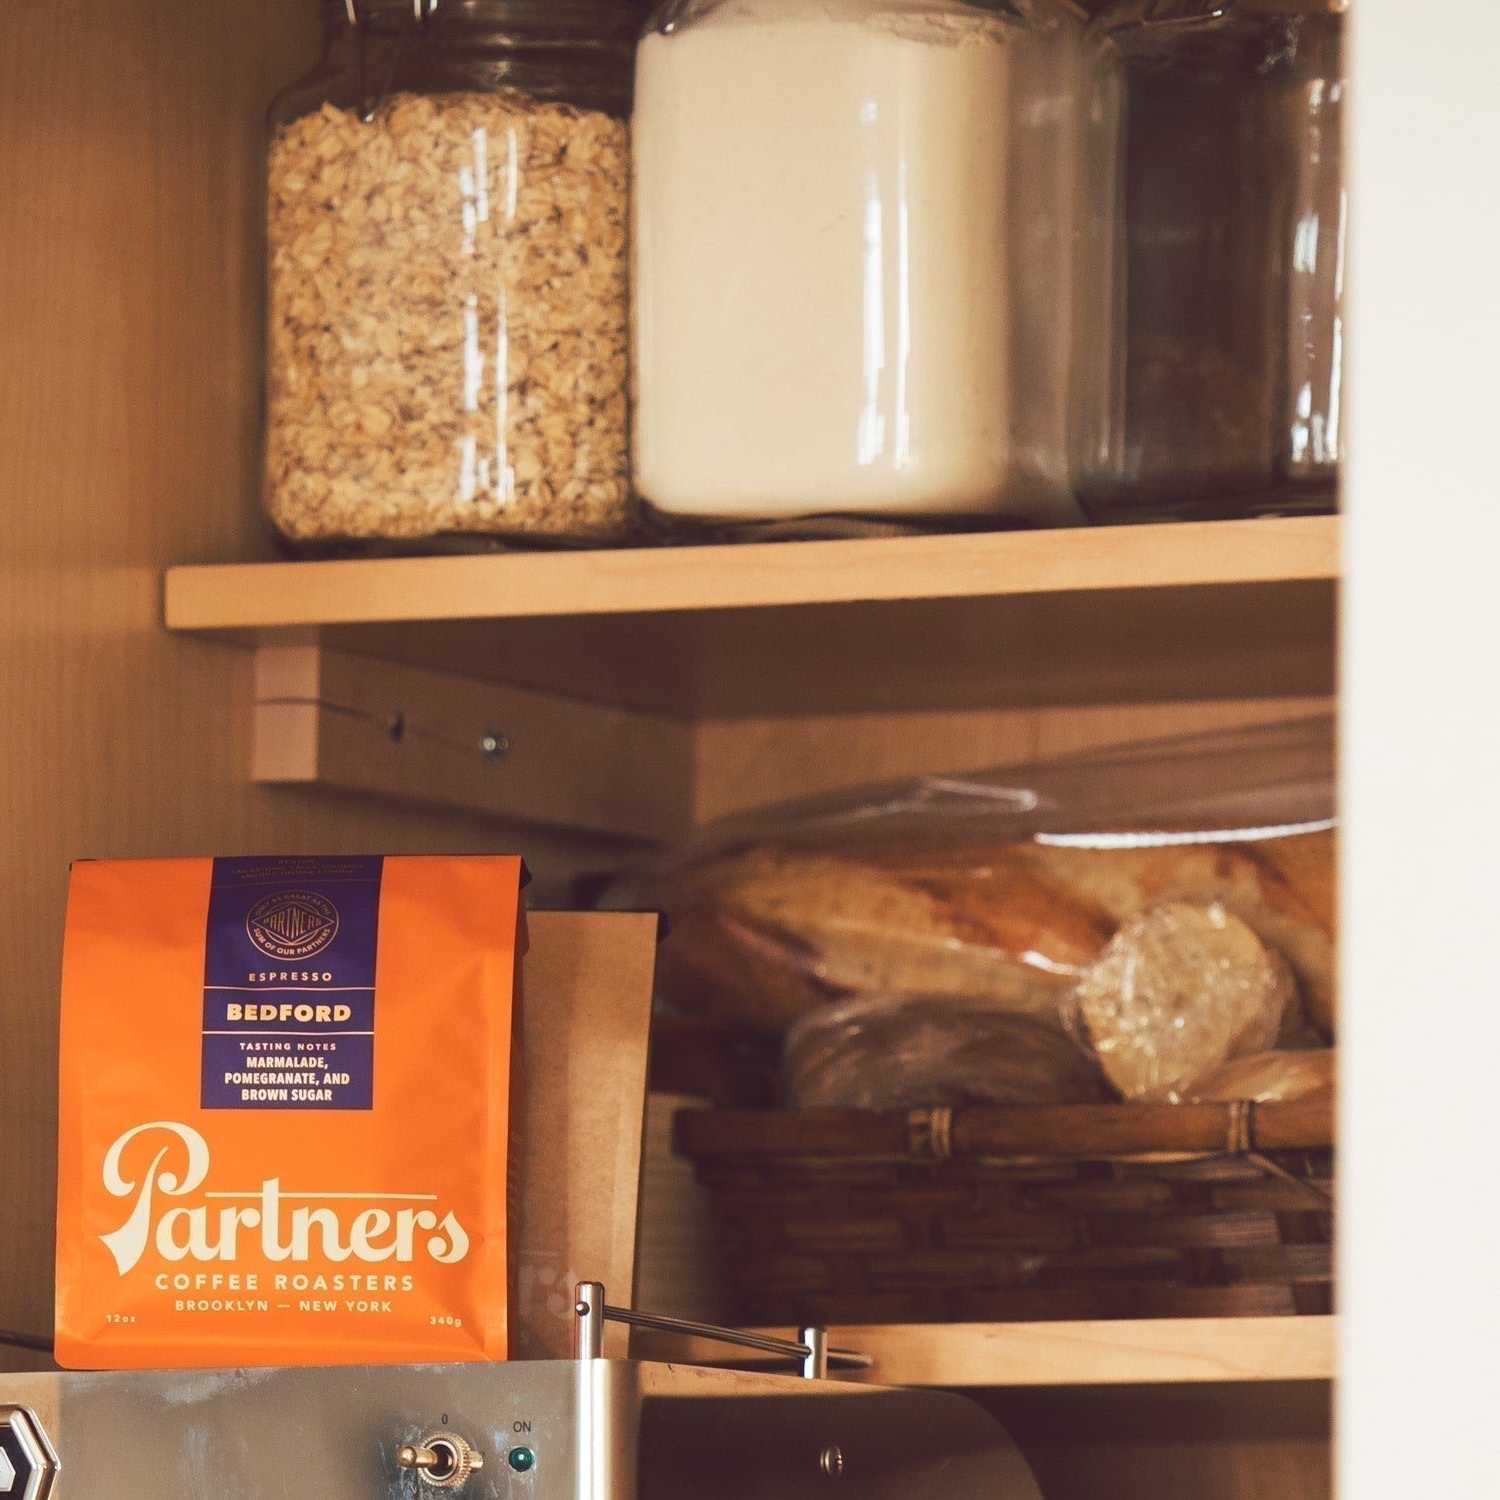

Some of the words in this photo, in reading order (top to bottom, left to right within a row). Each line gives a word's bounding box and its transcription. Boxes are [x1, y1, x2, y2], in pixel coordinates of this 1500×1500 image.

[263, 907, 322, 939] PARTNERS
[253, 927, 266, 944] SUM
[265, 942, 277, 951] OF
[277, 946, 295, 955] OUR
[297, 928, 332, 954] PARTNERS
[249, 971, 332, 982] ESPRESSO
[226, 1003, 352, 1023] BEDFORD
[239, 1042, 291, 1051] TASTING
[297, 1043, 337, 1051] NOTES
[246, 1056, 329, 1070] MARMALADE,
[224, 1072, 320, 1086] POMEGRANATE,
[323, 1073, 350, 1085] AND
[241, 1088, 288, 1101] BROWN
[291, 1088, 333, 1101] SUGAR
[98, 1121, 470, 1277] Partners
[155, 1273, 258, 1291] COFFEE
[275, 1274, 414, 1292] ROASTERS
[175, 1299, 269, 1312] BROOKLYN
[299, 1300, 338, 1312] NEW
[346, 1300, 392, 1313] YORK
[105, 1313, 136, 1323] 12oz
[429, 1315, 463, 1328] 340g
[513, 1420, 532, 1433] ON
